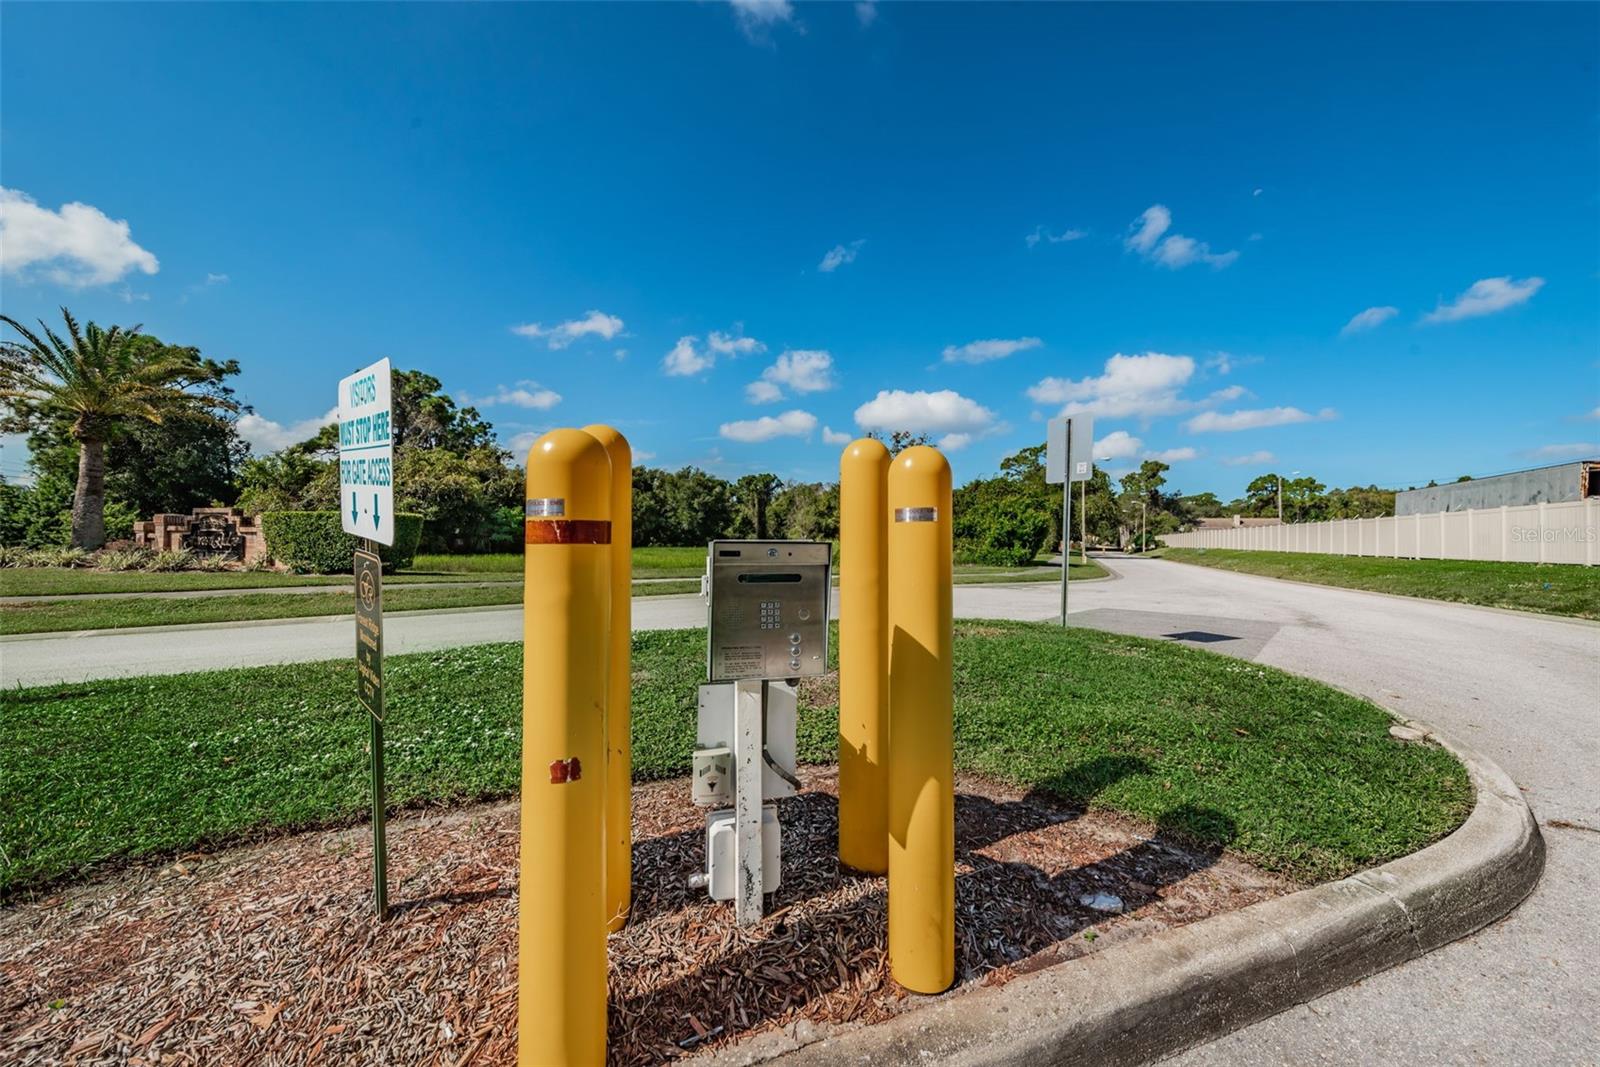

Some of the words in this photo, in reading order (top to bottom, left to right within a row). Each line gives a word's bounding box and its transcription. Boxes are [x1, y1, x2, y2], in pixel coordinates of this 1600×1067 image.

[350, 374, 375, 408] VISITORS
[340, 419, 354, 447] MUST
[356, 415, 371, 444] STOP
[373, 410, 390, 442] HERE
[341, 459, 352, 485] FOR
[352, 459, 367, 486] GATE
[368, 457, 391, 487] ACCESS
